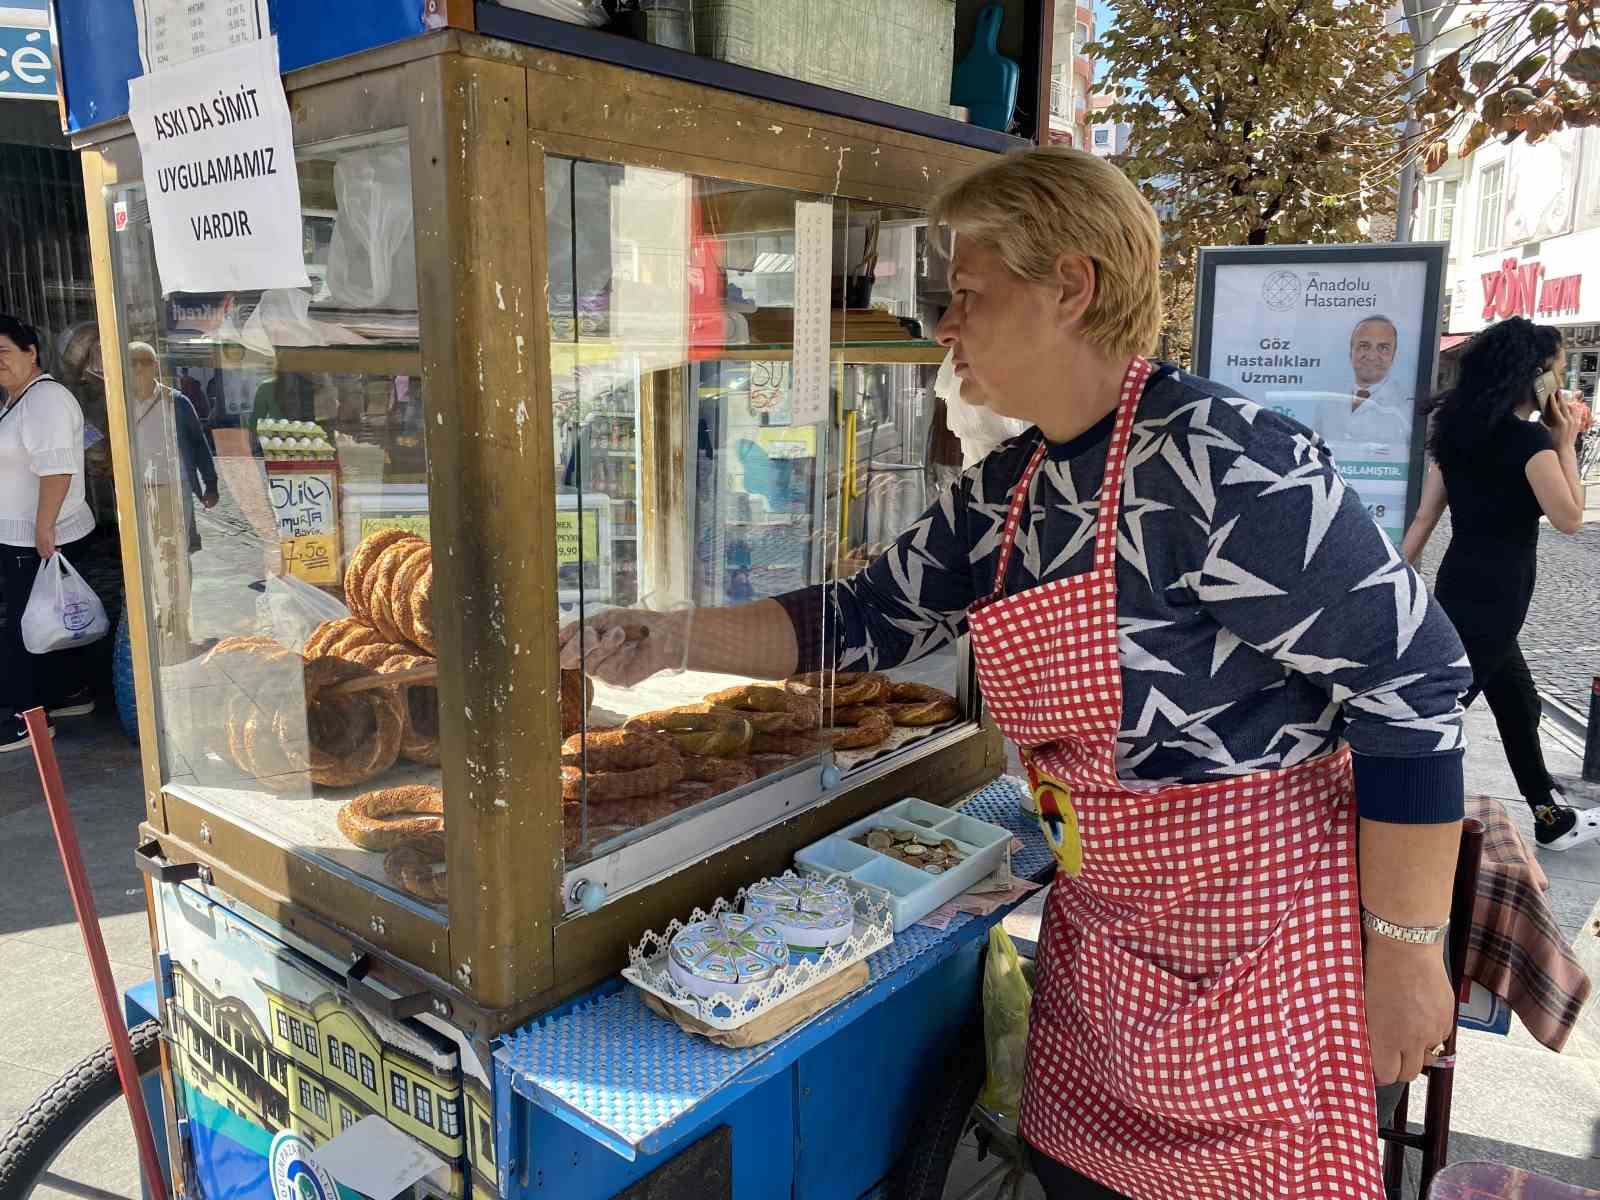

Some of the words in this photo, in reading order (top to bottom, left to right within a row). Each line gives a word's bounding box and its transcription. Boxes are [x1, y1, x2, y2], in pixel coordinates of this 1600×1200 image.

[154, 108, 188, 140] ASKI
[187, 102, 214, 132] DA
[213, 84, 260, 126] SİMİT
[158, 147, 277, 193] UYGULAMAMIZ
[191, 210, 252, 241] VARDIR
[1306, 277, 1370, 291] Anadolu
[1305, 293, 1377, 307] Hastanesi
[1260, 337, 1291, 350] Göz
[1226, 355, 1321, 368] Hastalıkları
[1241, 371, 1303, 384] Uzmanı
